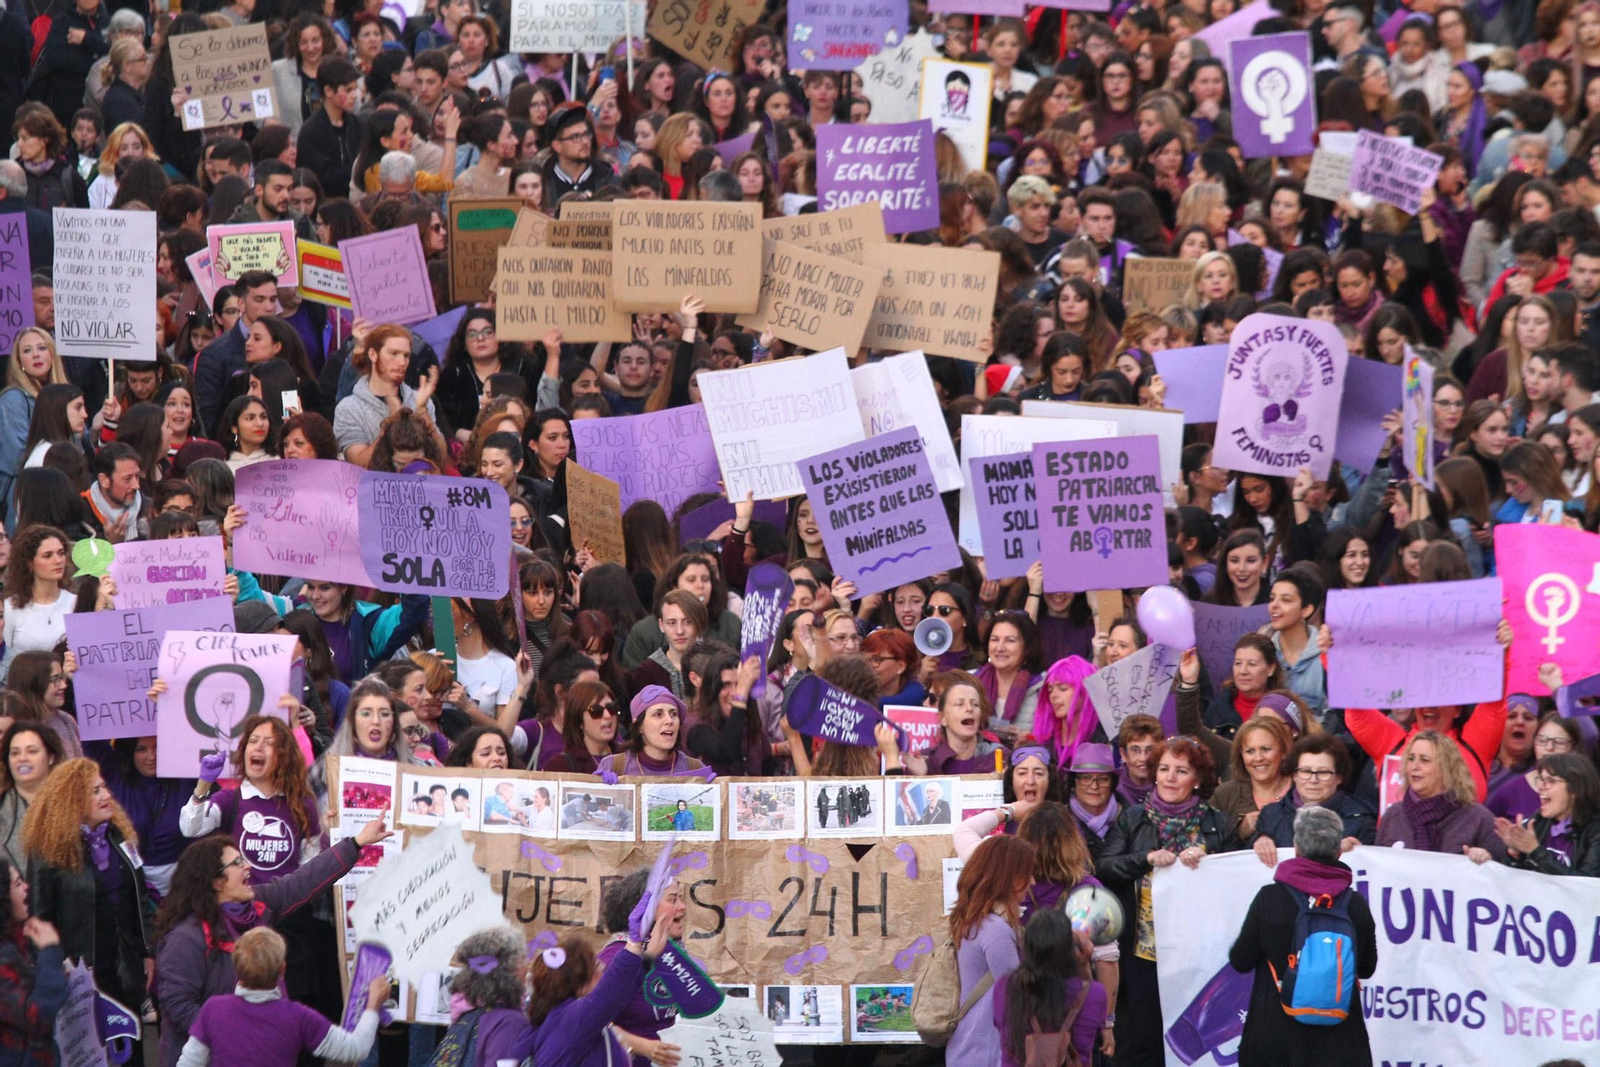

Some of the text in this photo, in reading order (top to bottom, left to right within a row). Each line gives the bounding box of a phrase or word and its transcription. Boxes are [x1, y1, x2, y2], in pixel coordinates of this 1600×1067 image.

[518, 3, 536, 18] SI
[517, 19, 597, 33] PARAMOS
[513, 34, 577, 49] PARA EL
[238, 59, 269, 75] NUNCA
[871, 61, 905, 90] PASO
[840, 128, 922, 154] LIBERTÉ
[833, 156, 920, 181] EGALITÉ
[823, 179, 926, 211] SORORITÉ
[95, 217, 127, 228] EN UNA
[619, 211, 641, 227] LOS
[819, 221, 831, 237] DE
[838, 218, 854, 233] TU
[102, 233, 121, 246] QUE
[552, 225, 570, 238] NO
[88, 249, 95, 260] A
[98, 250, 113, 261] LAS
[115, 249, 155, 264] MUJERES
[621, 237, 736, 256] MUCHO ANTES QUE
[54, 264, 123, 276] A DE NO
[502, 258, 612, 277] NOS QUITARON TANTO
[626, 266, 649, 287] LAS
[766, 253, 865, 299] NO NACÍ MUJER
[55, 279, 132, 294] VIOLADAS EN VEZ
[527, 280, 545, 297] NOS
[905, 270, 986, 291] POR LA CALLE
[101, 297, 108, 307] A
[112, 299, 131, 309] LOS
[760, 274, 854, 317] PARA MORIR POR
[106, 310, 115, 321] A
[503, 305, 606, 326] HASTA EL MIEDO
[767, 301, 821, 336] SERLO
[874, 296, 981, 322] HOY NO VOY SOL
[61, 320, 137, 340] NO VIOLAR
[580, 424, 625, 448] SOMOS
[630, 420, 659, 447] LAS
[583, 441, 690, 472] DE LAS BRUJAS
[1231, 427, 1311, 467] FEMINISTAS
[809, 459, 844, 485] LOS
[1046, 451, 1129, 477] ESTADO
[618, 475, 634, 496] NO
[988, 485, 1018, 506] HOY
[446, 486, 492, 509] #8M
[829, 483, 935, 531] ANTES QUE LAS
[1052, 503, 1153, 527] TE VAMOS
[160, 545, 191, 561] Madre
[381, 528, 495, 560] HOY NO VOY
[1004, 538, 1024, 560] LA
[382, 553, 496, 587] SOLA POR LA
[123, 613, 154, 637] EL
[1127, 664, 1146, 707] ES LA
[1157, 664, 1177, 686] LA
[820, 723, 838, 739] UN
[245, 839, 290, 852] MUJERES
[257, 851, 277, 863] 24H
[415, 882, 451, 920] MENOS
[374, 901, 396, 932] MÁS
[1381, 887, 1455, 945] UN
[1467, 898, 1577, 968] PASO
[661, 952, 702, 996] #M24H
[1363, 986, 1487, 1030] UESTROS
[713, 1013, 735, 1039] SOY
[734, 1016, 757, 1042] SOY
